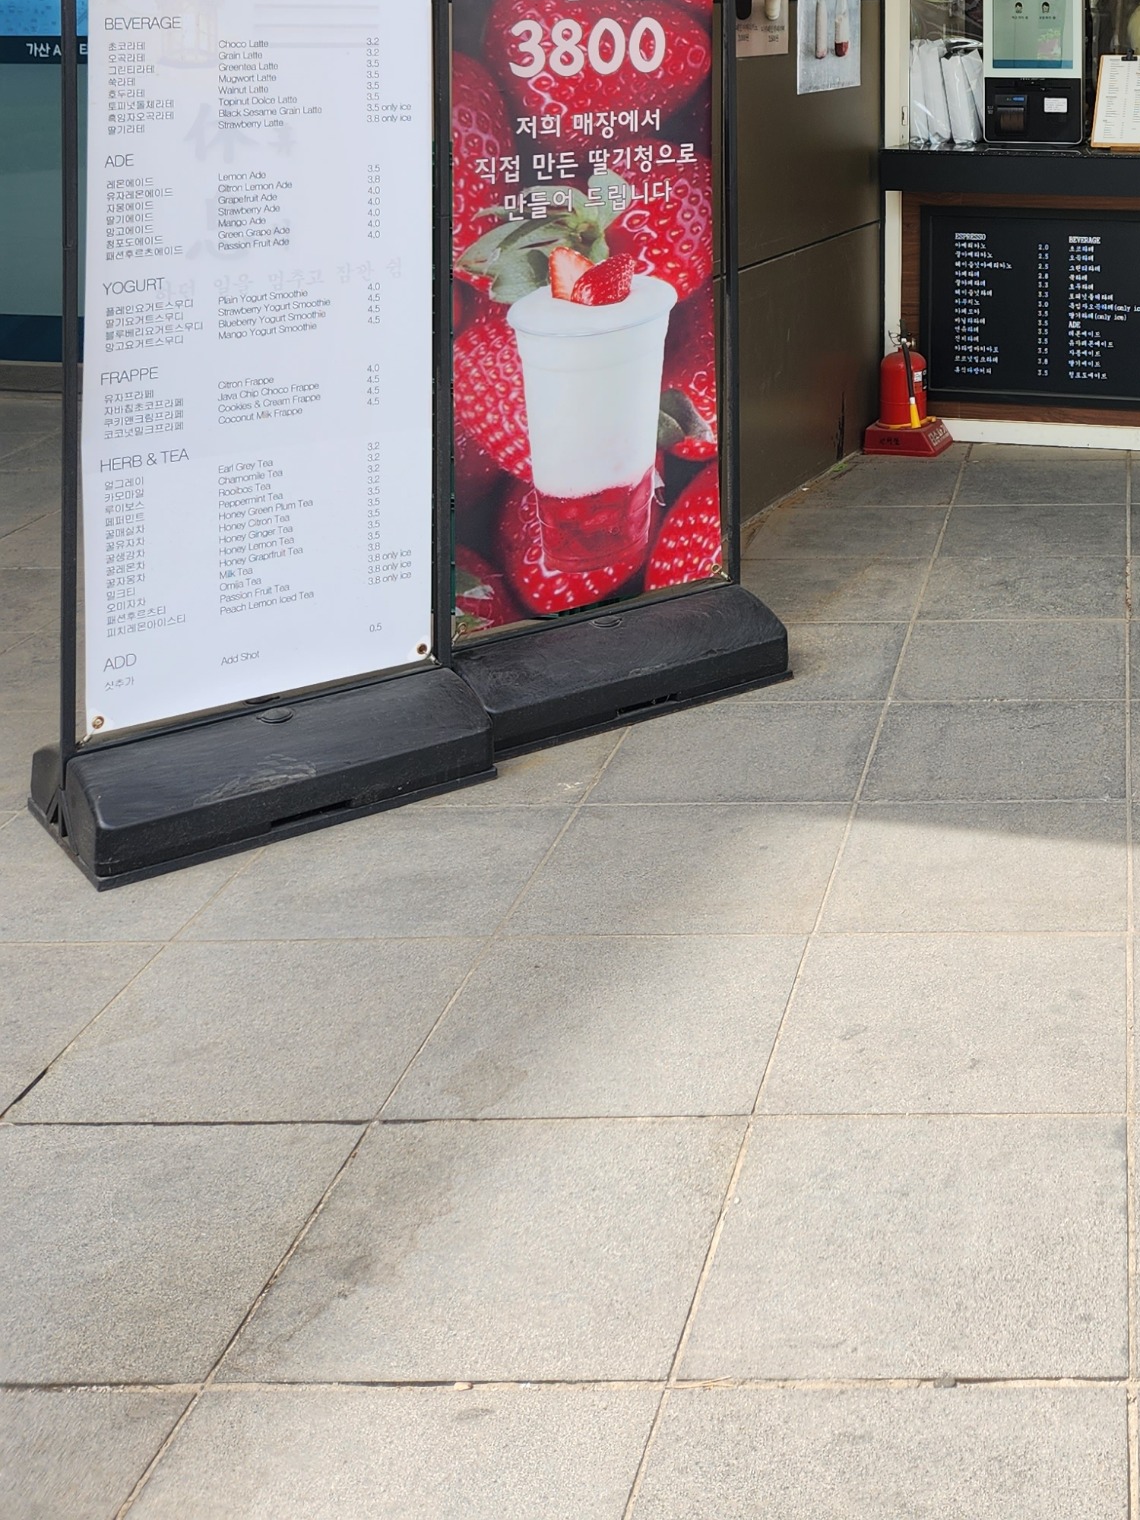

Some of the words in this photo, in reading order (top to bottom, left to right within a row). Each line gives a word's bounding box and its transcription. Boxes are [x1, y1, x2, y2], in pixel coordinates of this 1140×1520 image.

[104, 16, 182, 31] BEVERAGE
[218, 40, 247, 49] Choco
[249, 39, 269, 48] Latte
[366, 38, 379, 46] 3.2
[509, 17, 665, 78] 3800
[26, 42, 51, 57] 가산
[218, 119, 262, 129] Strawberry
[263, 118, 284, 127] Latte
[366, 114, 380, 123] 3.8
[381, 113, 398, 124] only
[516, 114, 562, 140] 저희
[573, 108, 660, 139] 매장에서
[104, 154, 134, 168] ADE
[474, 155, 520, 184] 직접
[533, 151, 578, 179] 만든
[588, 143, 697, 176] 딸기청으로
[367, 164, 380, 173] 3.5
[218, 171, 247, 182] Lemon
[249, 170, 266, 180] Ade
[504, 189, 573, 220] 만들어
[584, 180, 672, 211] 드립니다
[1069, 236, 1100, 244] BEVERAGE
[103, 277, 165, 296] YOGURT
[367, 282, 380, 292] 4.0
[218, 294, 239, 305] Plain
[240, 291, 269, 304] Yogurt
[270, 289, 308, 300] Smoothie
[100, 366, 159, 385] FRAPPE
[367, 364, 380, 373] 4.0
[218, 378, 243, 390] Citron
[245, 376, 274, 388] Frappe
[367, 442, 380, 451] 3.2
[100, 454, 143, 473] HERB
[146, 452, 157, 466] &
[161, 448, 190, 464] TEA
[218, 464, 234, 474] Earl
[235, 460, 256, 473] Grey
[257, 458, 274, 469] Tea
[369, 622, 382, 632] 0.5
[103, 653, 137, 672] ADD
[221, 654, 238, 666] Add
[240, 651, 260, 662] Shot
